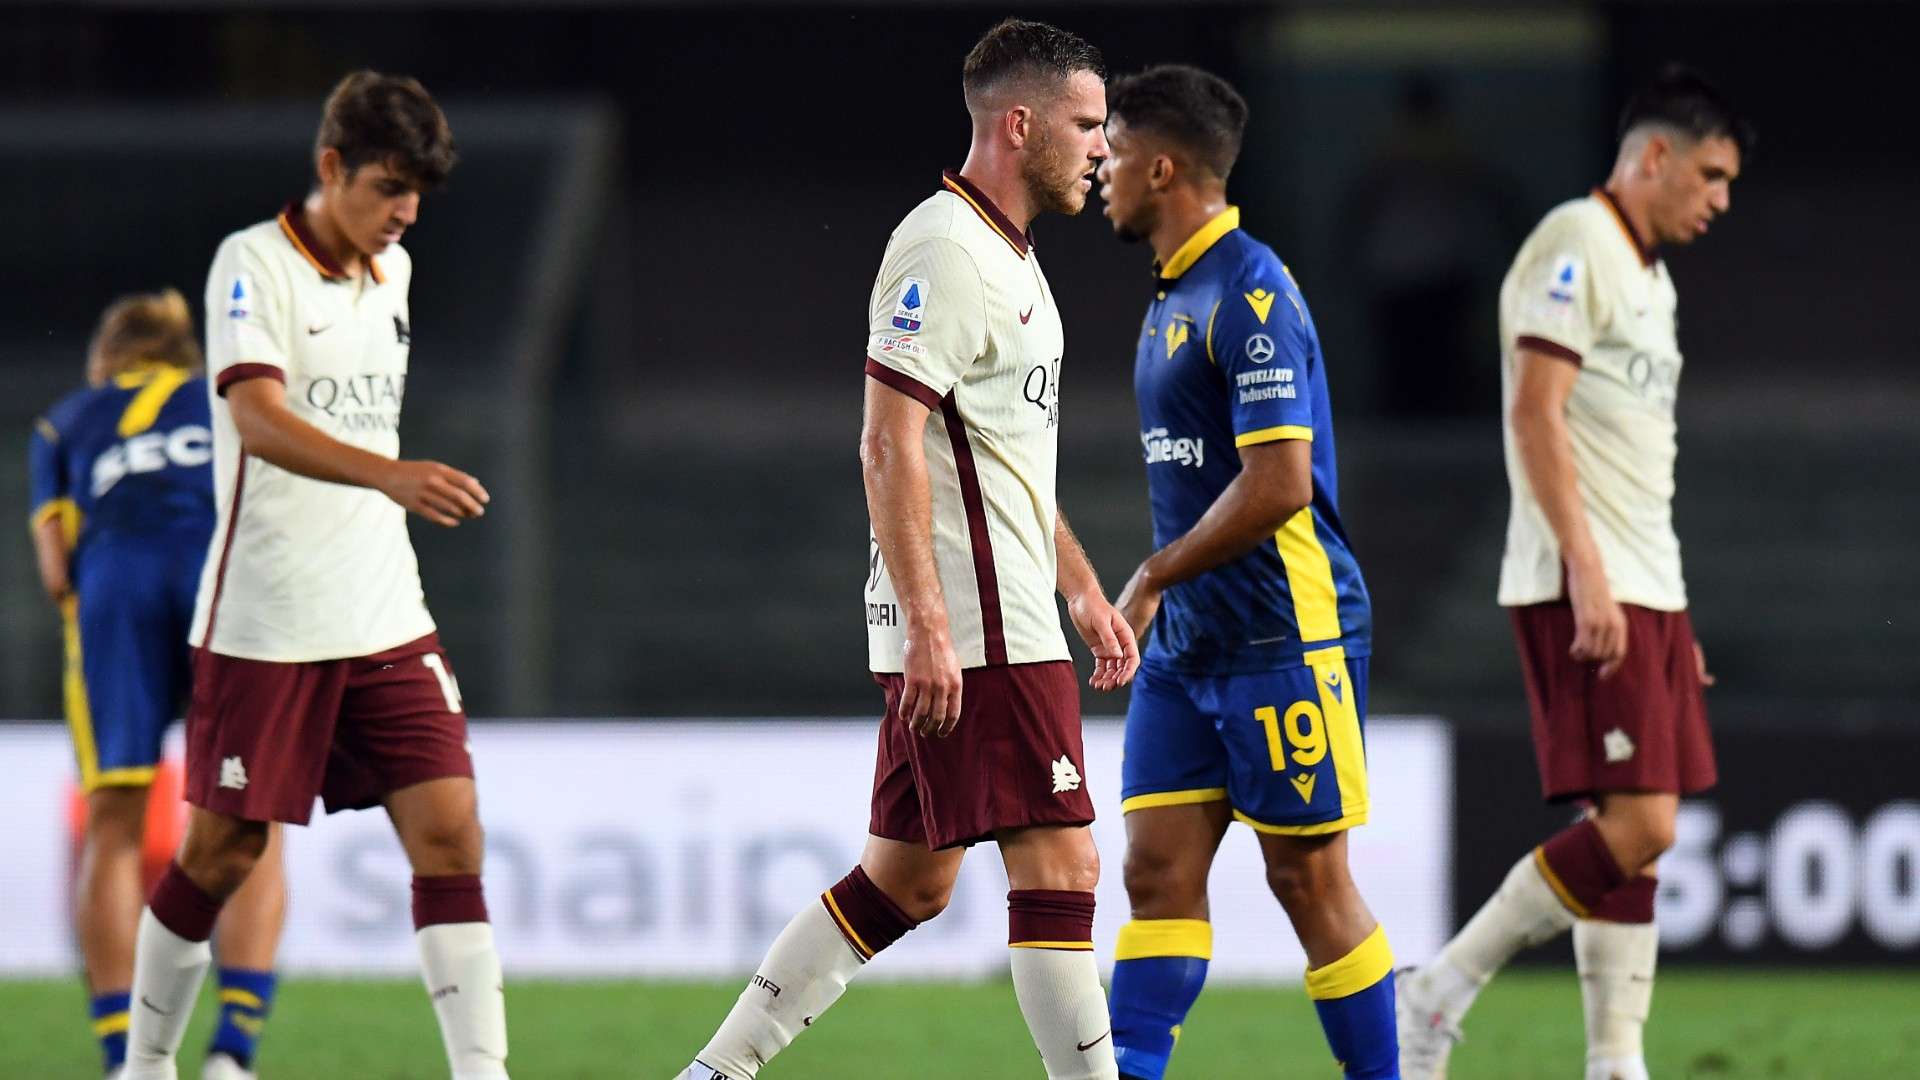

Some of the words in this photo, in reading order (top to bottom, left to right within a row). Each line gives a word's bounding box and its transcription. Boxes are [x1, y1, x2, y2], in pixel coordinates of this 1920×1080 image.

[898, 309, 914, 318] SERIE
[884, 337, 911, 351] RACISM
[114, 361, 189, 438] 7
[1254, 700, 1328, 772] 19
